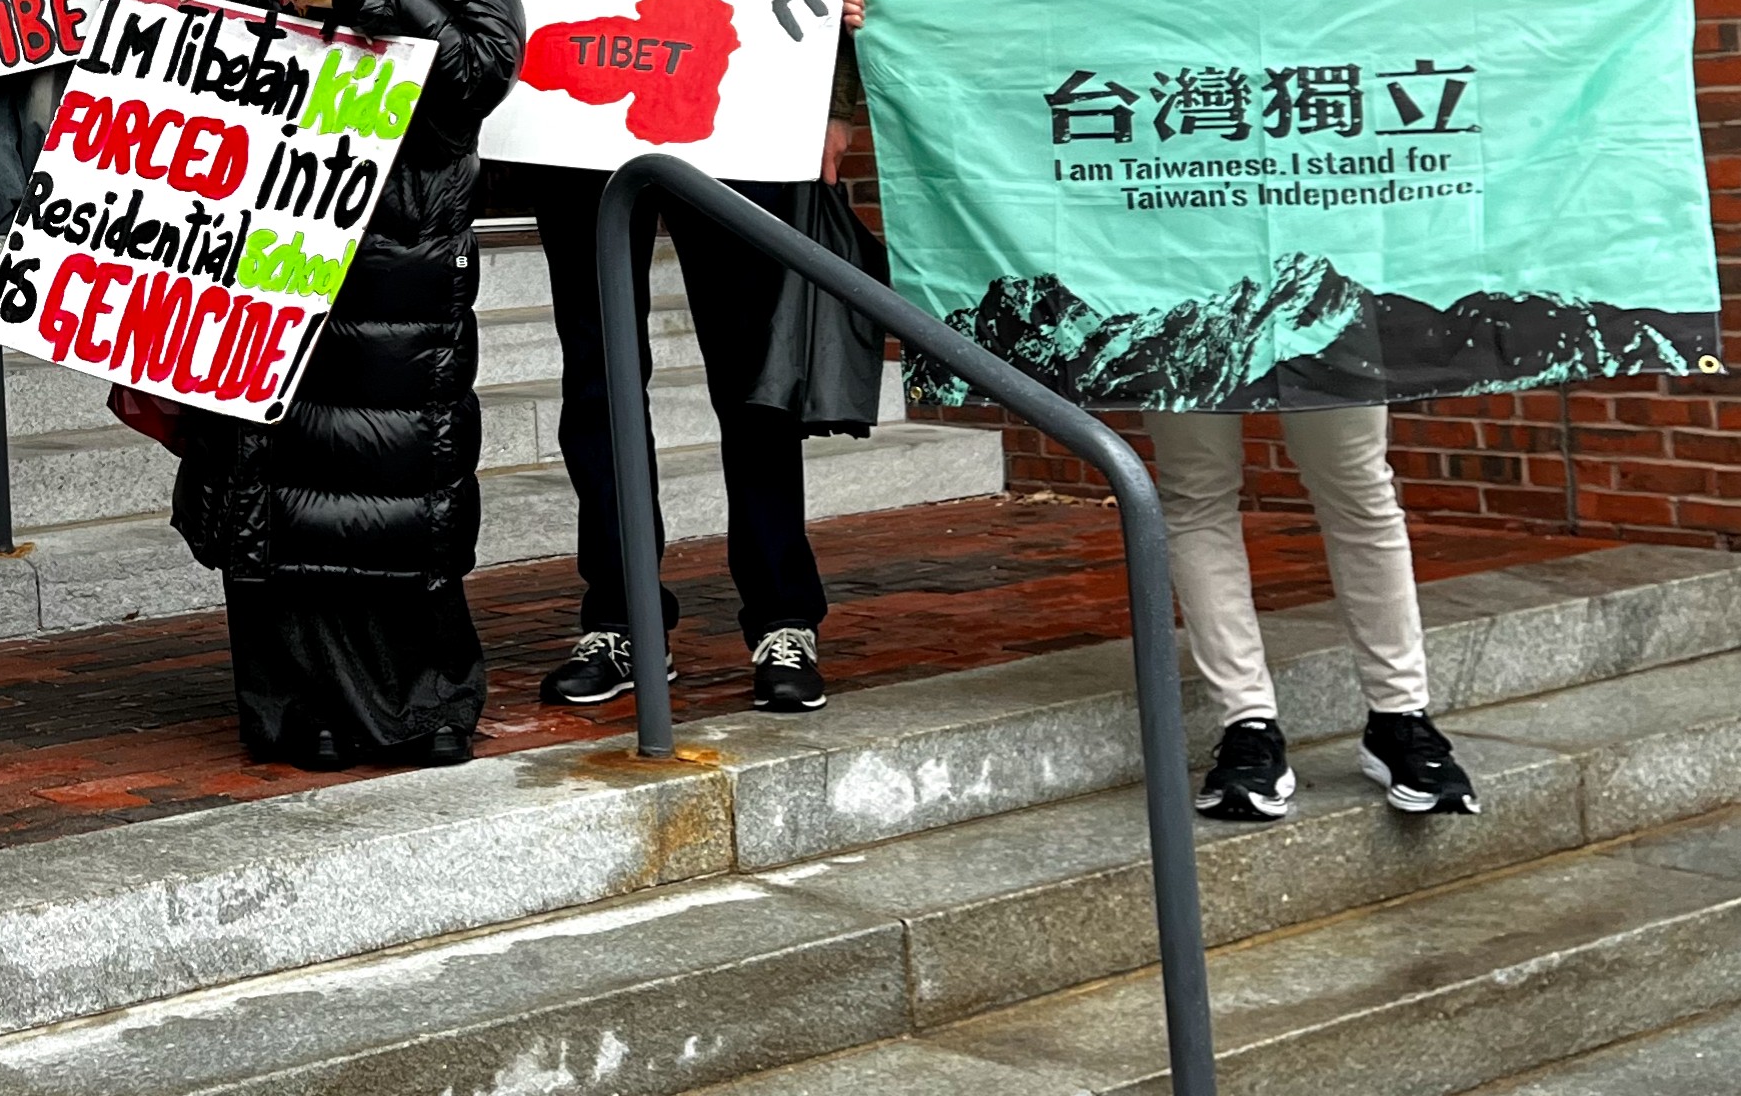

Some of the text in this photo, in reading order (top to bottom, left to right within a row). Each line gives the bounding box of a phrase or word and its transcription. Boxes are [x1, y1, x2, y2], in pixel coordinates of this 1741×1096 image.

[163, 4, 311, 121] Tibetan
[569, 34, 693, 74] TIBET
[1043, 59, 1482, 144] 台灣獨立
[44, 91, 378, 229] FORCED into
[1054, 146, 1451, 181] I am Taiwanese. I stand for
[1121, 179, 1483, 210] Taiwan's Independence.
[16, 171, 251, 288] Residential
[38, 253, 327, 421] GENOCIDE!
